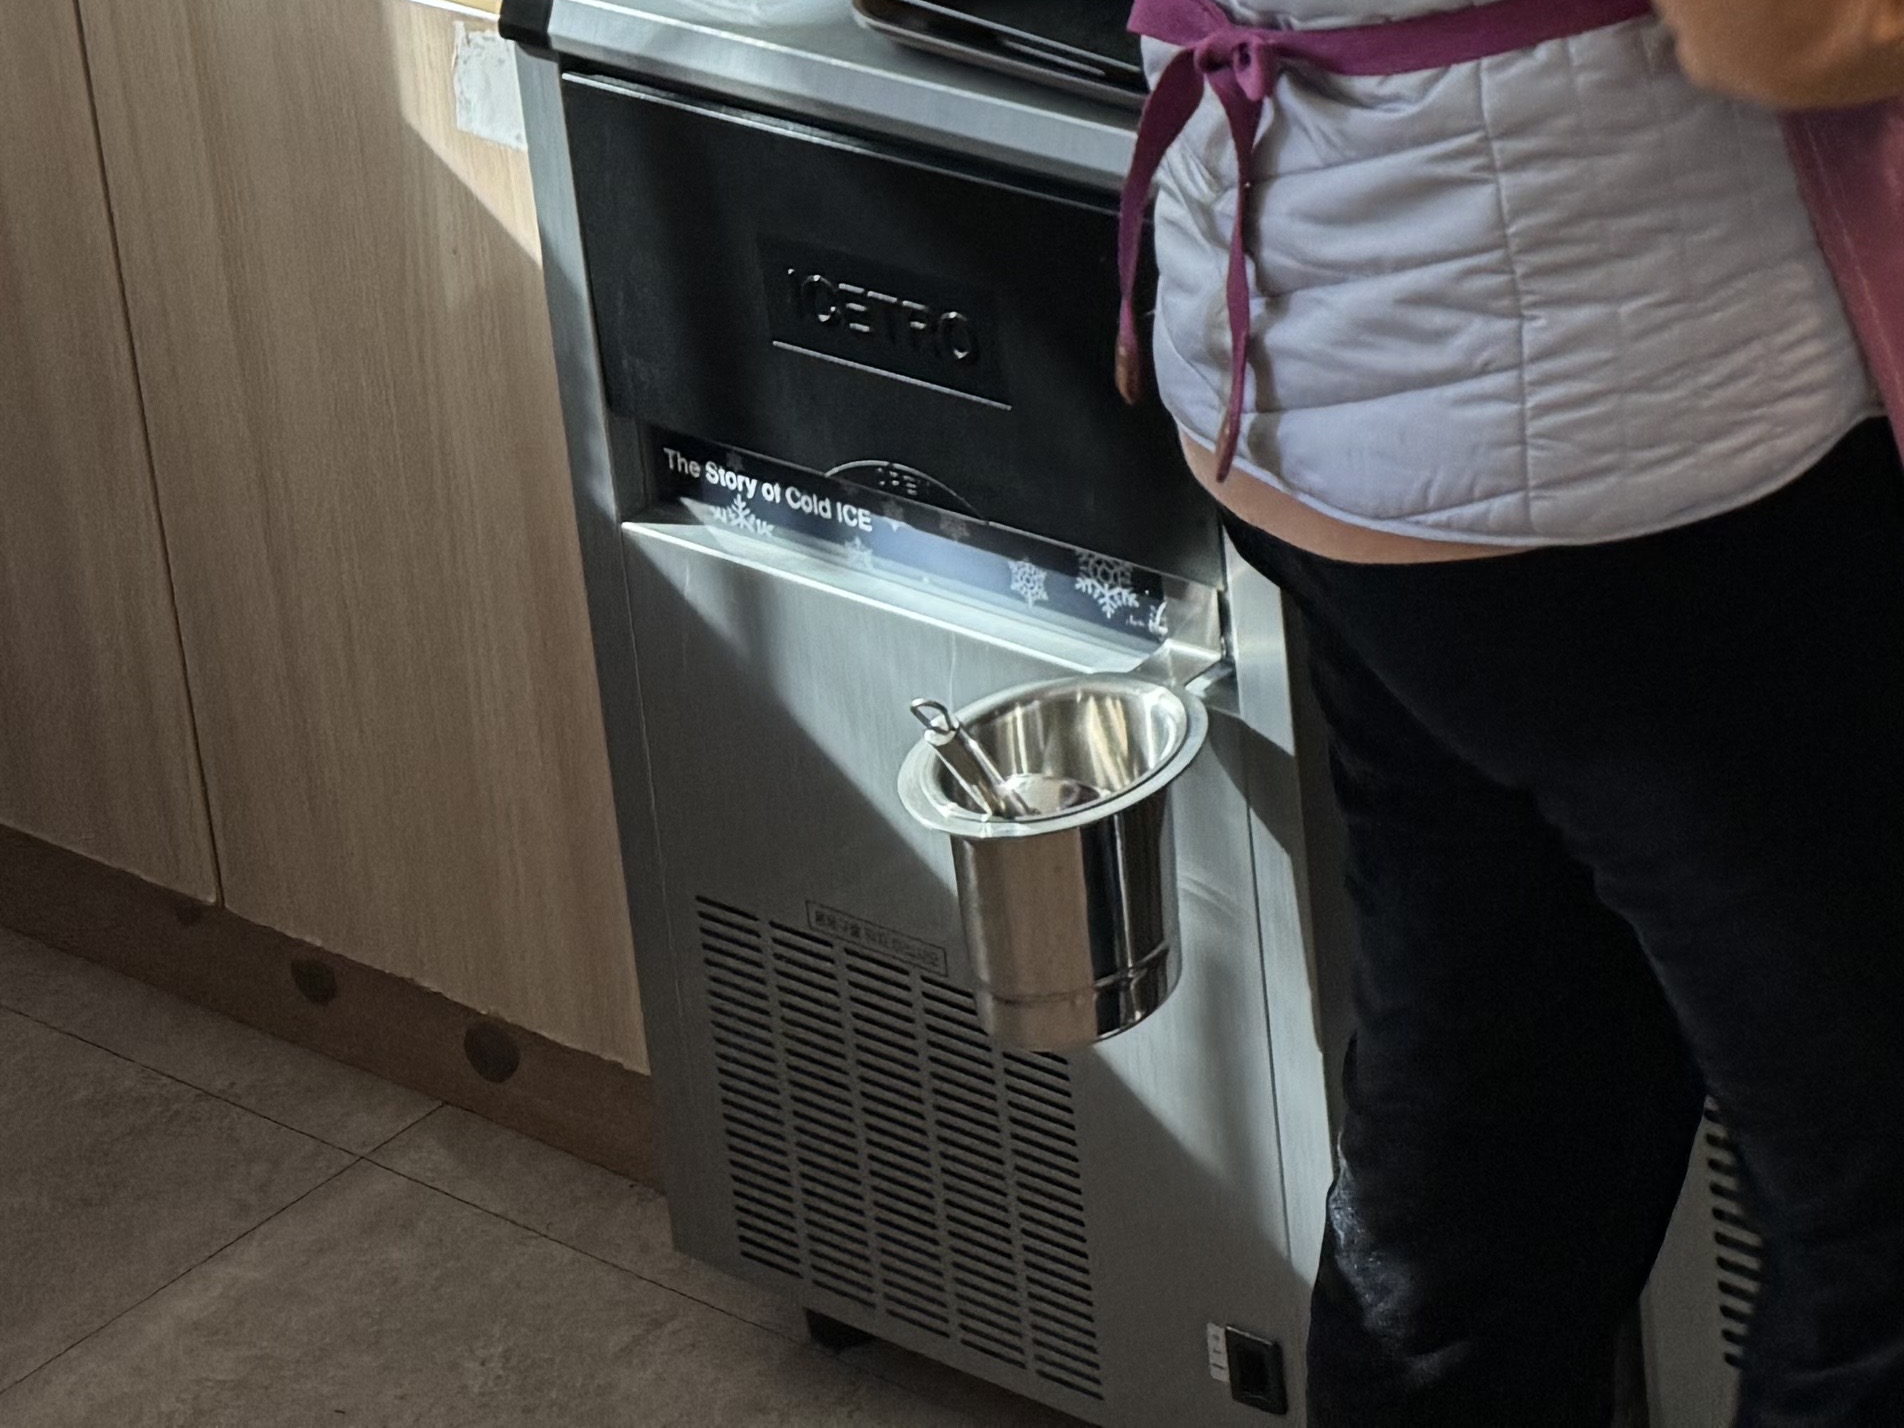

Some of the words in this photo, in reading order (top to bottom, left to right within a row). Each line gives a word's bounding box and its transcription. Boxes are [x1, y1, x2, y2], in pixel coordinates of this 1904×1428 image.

[664, 448, 701, 478] The
[705, 462, 758, 500] Story
[762, 479, 782, 503] of
[785, 487, 832, 520] Cold
[837, 503, 873, 533] ICE
